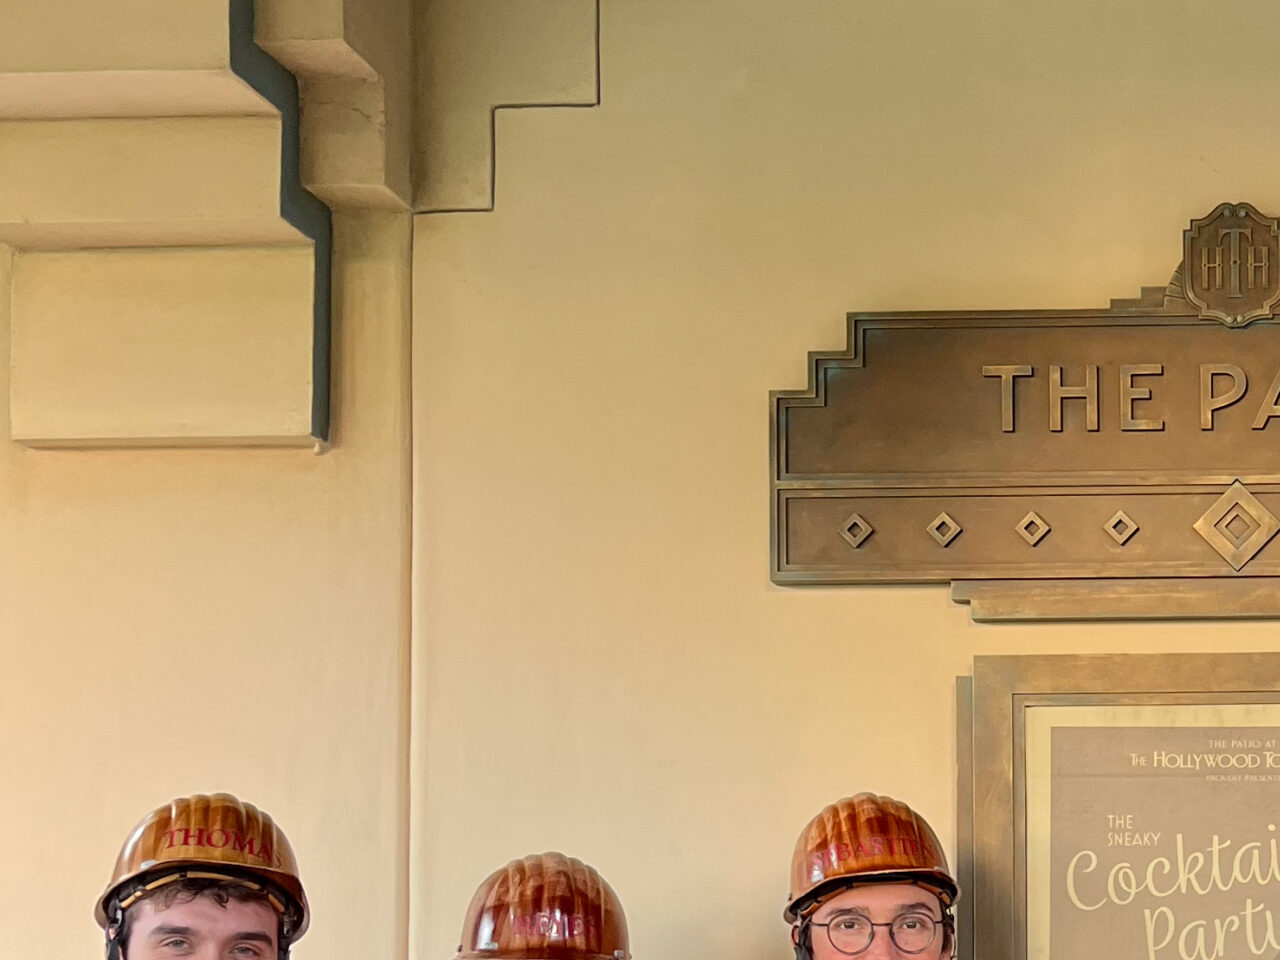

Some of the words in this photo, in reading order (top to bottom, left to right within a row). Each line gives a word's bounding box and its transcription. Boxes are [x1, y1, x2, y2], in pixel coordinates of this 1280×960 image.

[982, 363, 1165, 433] THE
[1208, 739, 1227, 749] THE
[1231, 739, 1261, 749] PATIO
[1264, 739, 1277, 749] AT
[1153, 750, 1260, 770] HOLLYWOOD
[1206, 774, 1242, 783] PROUDLY
[1107, 814, 1134, 830] THE
[1107, 832, 1162, 847] SNEAKY
